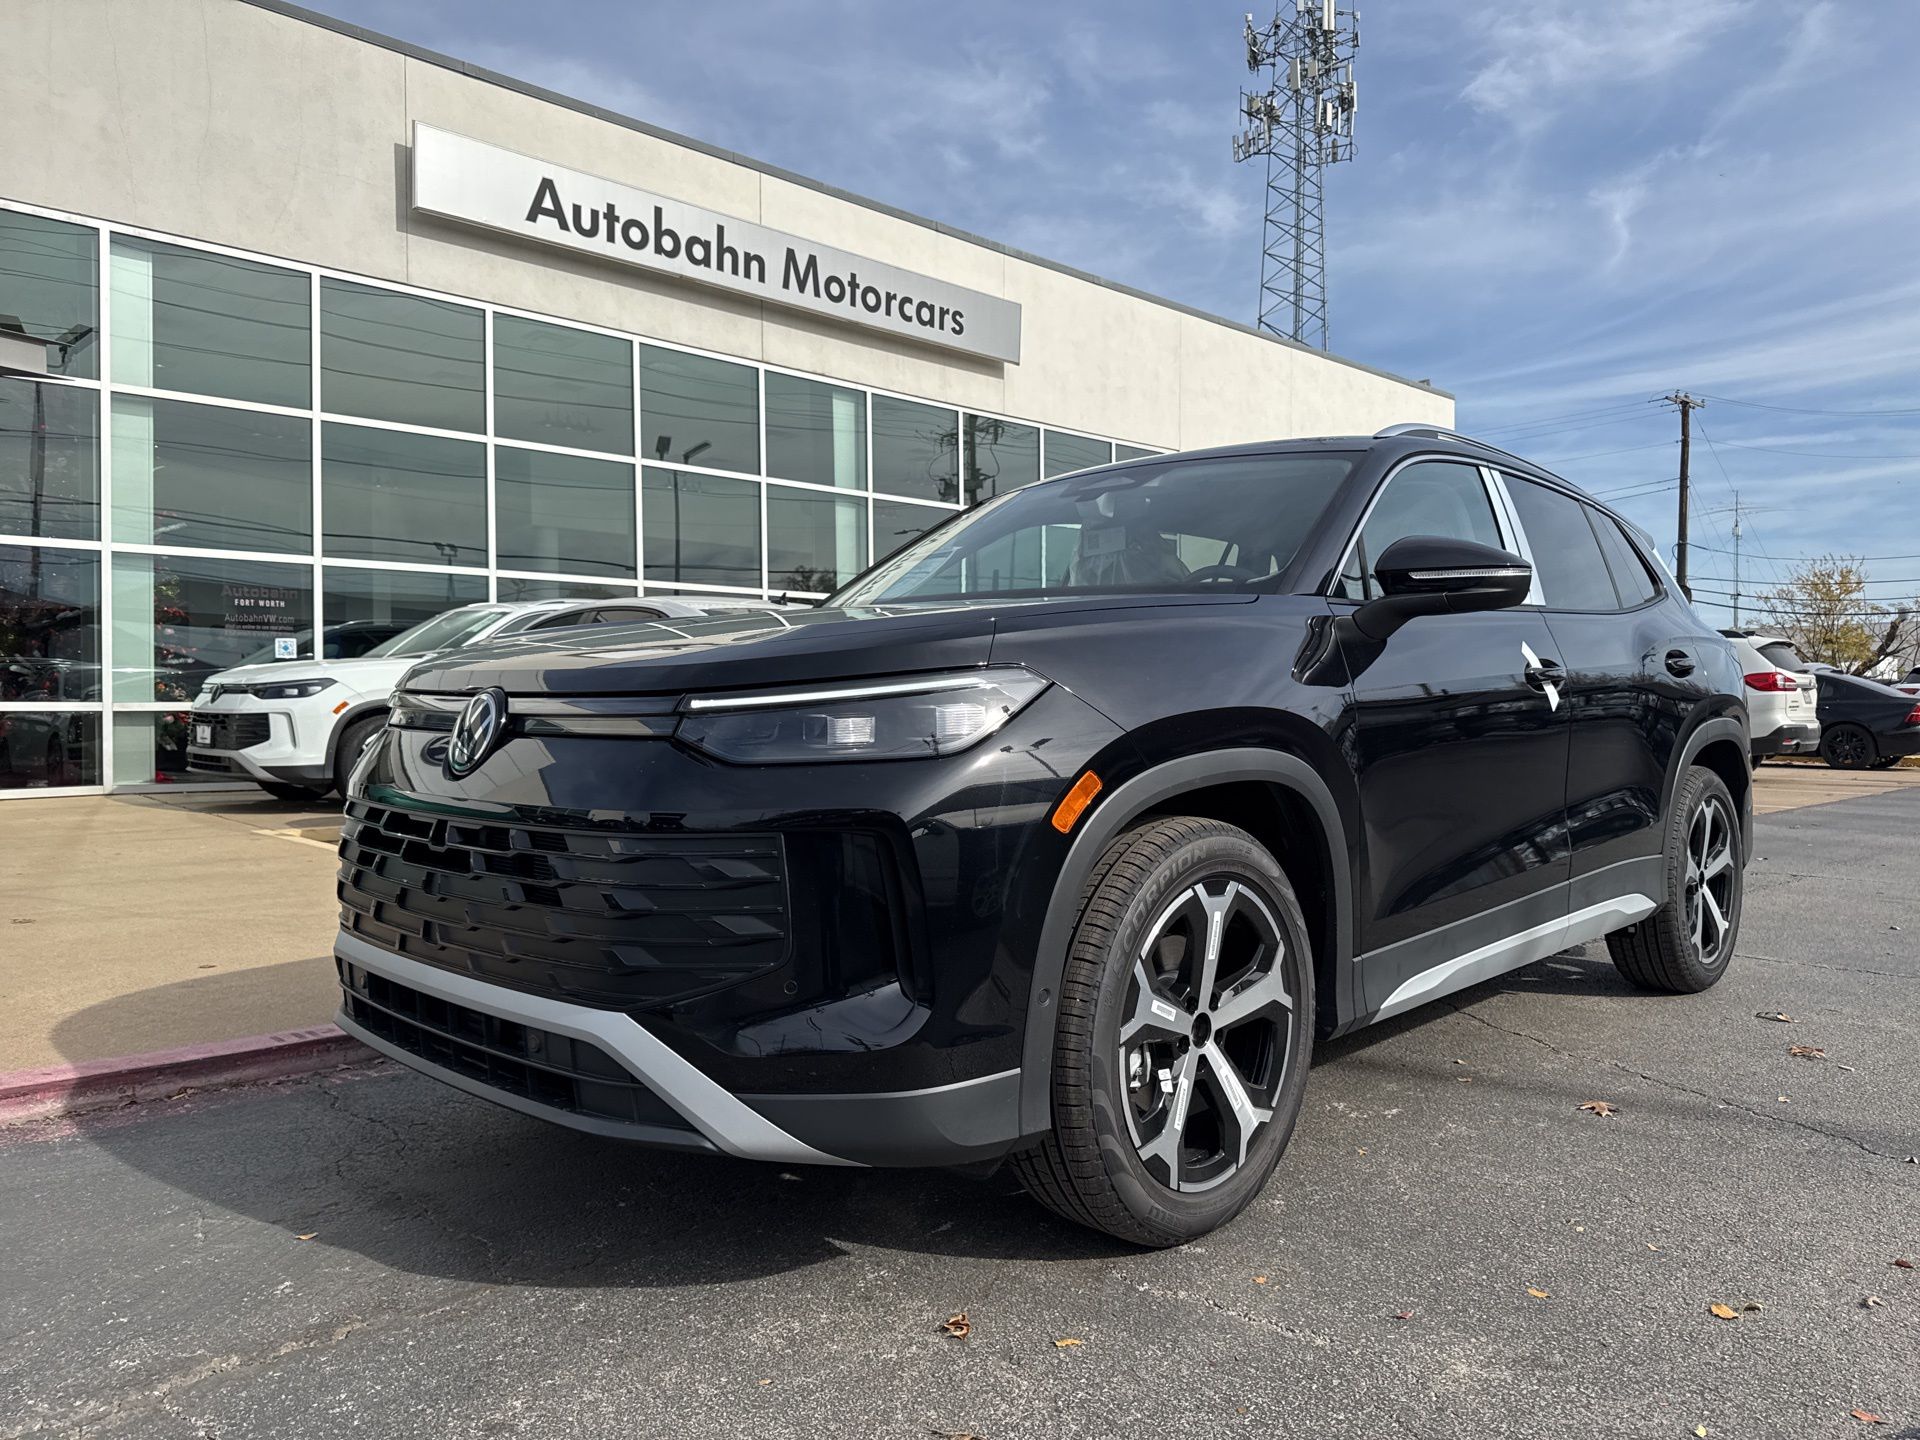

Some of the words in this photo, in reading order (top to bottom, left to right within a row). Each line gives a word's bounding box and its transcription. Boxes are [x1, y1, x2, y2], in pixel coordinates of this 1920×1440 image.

[525, 176, 766, 284] Autobahn
[782, 246, 966, 336] Motorcars
[221, 585, 298, 599] Autobahn
[234, 598, 255, 606] FORT
[258, 599, 286, 608] WORTH
[224, 613, 295, 623] AutobahnVW.com
